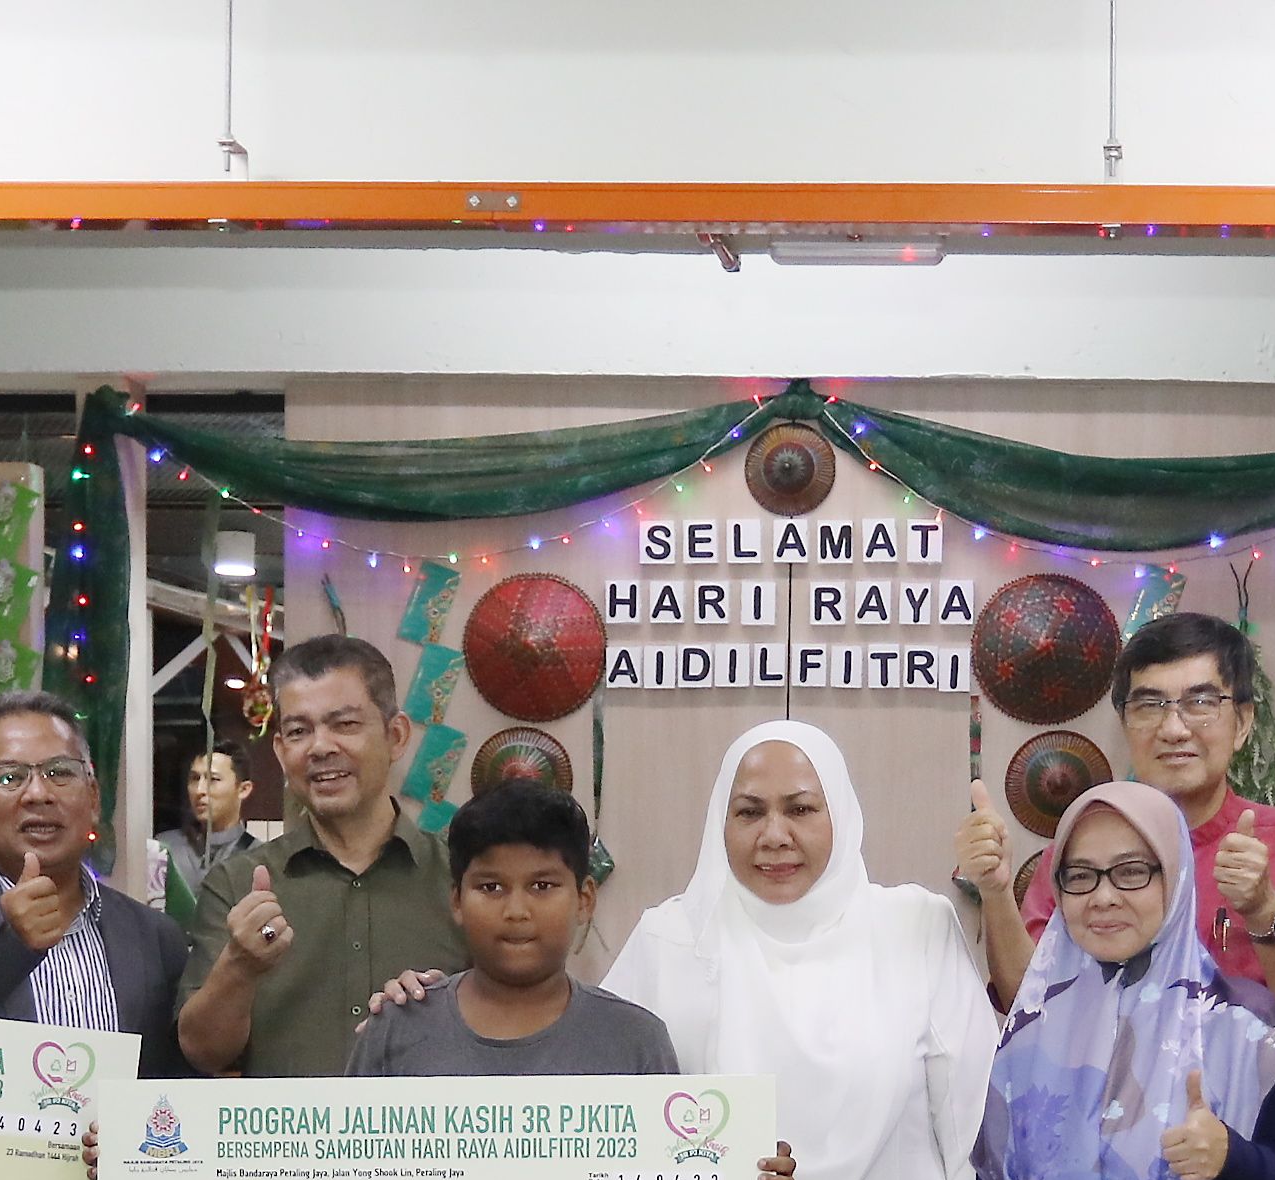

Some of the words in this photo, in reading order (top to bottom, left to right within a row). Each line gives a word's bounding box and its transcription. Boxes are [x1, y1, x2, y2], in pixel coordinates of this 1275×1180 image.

[645, 523, 939, 560] SELAMAT
[609, 583, 762, 620] HARI
[814, 585, 972, 624] RAYA
[608, 647, 959, 690] AIDILFITRI
[219, 1106, 330, 1135] PROGRAM
[338, 1106, 435, 1134] JALINAN
[445, 1105, 512, 1133] KASIH
[522, 1105, 550, 1133] 3R
[560, 1104, 637, 1133] PJKITA
[217, 1141, 309, 1158] BERSEMPENA
[315, 1138, 405, 1159] SAMBUTAN
[412, 1138, 450, 1159] HARI
[457, 1137, 498, 1158] RAYA
[503, 1137, 589, 1158] AIDILFITRI
[596, 1137, 636, 1158] 2023
[216, 1168, 237, 1179] Majlis
[239, 1168, 278, 1178] Bandaraya
[279, 1168, 310, 1179] Petaling
[312, 1168, 329, 1179] Jaya,
[331, 1168, 350, 1178] Jalan
[352, 1168, 372, 1179] Yong
[374, 1168, 397, 1176] Shook
[400, 1168, 414, 1177] Lin,
[415, 1168, 446, 1178] Petaling
[449, 1168, 464, 1178] Jaya
